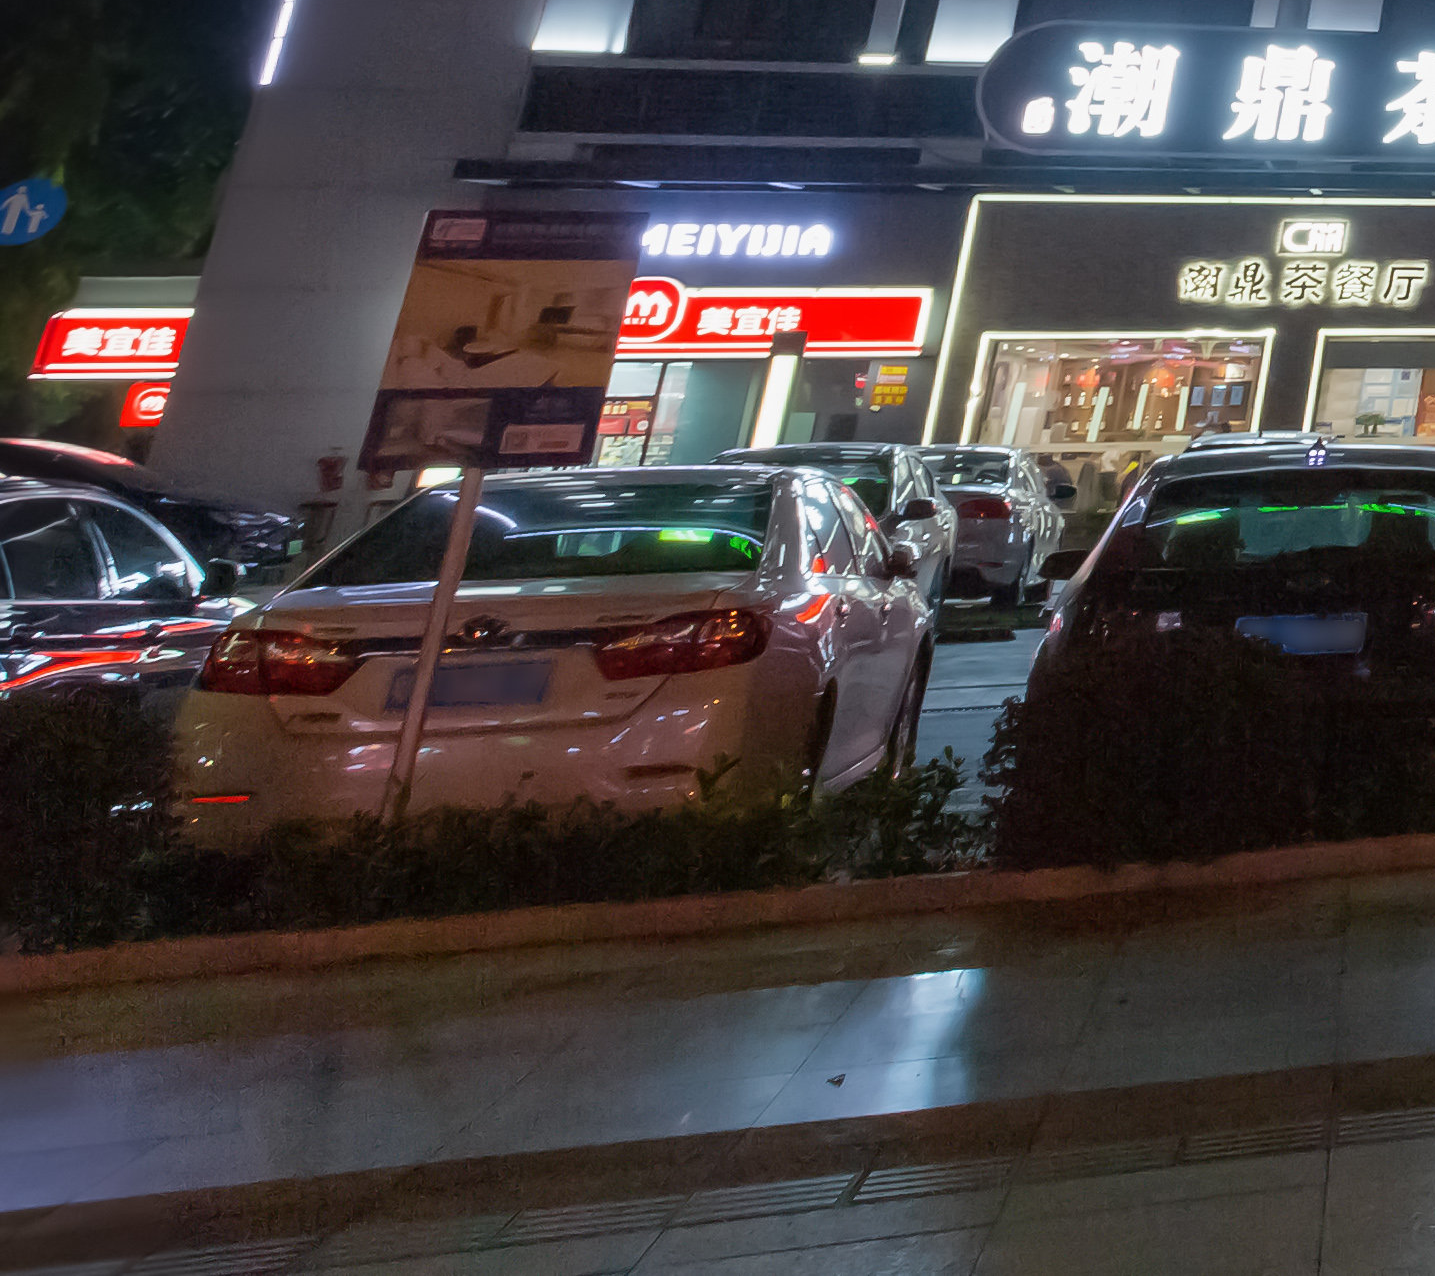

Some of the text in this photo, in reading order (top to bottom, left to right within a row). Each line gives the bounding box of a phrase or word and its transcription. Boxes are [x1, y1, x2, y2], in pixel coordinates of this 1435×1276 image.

[1180, 260, 1428, 306] 潮鼎茶餐厅
[697, 306, 801, 336] 美宜佳
[62, 326, 177, 357] 美宜佳
